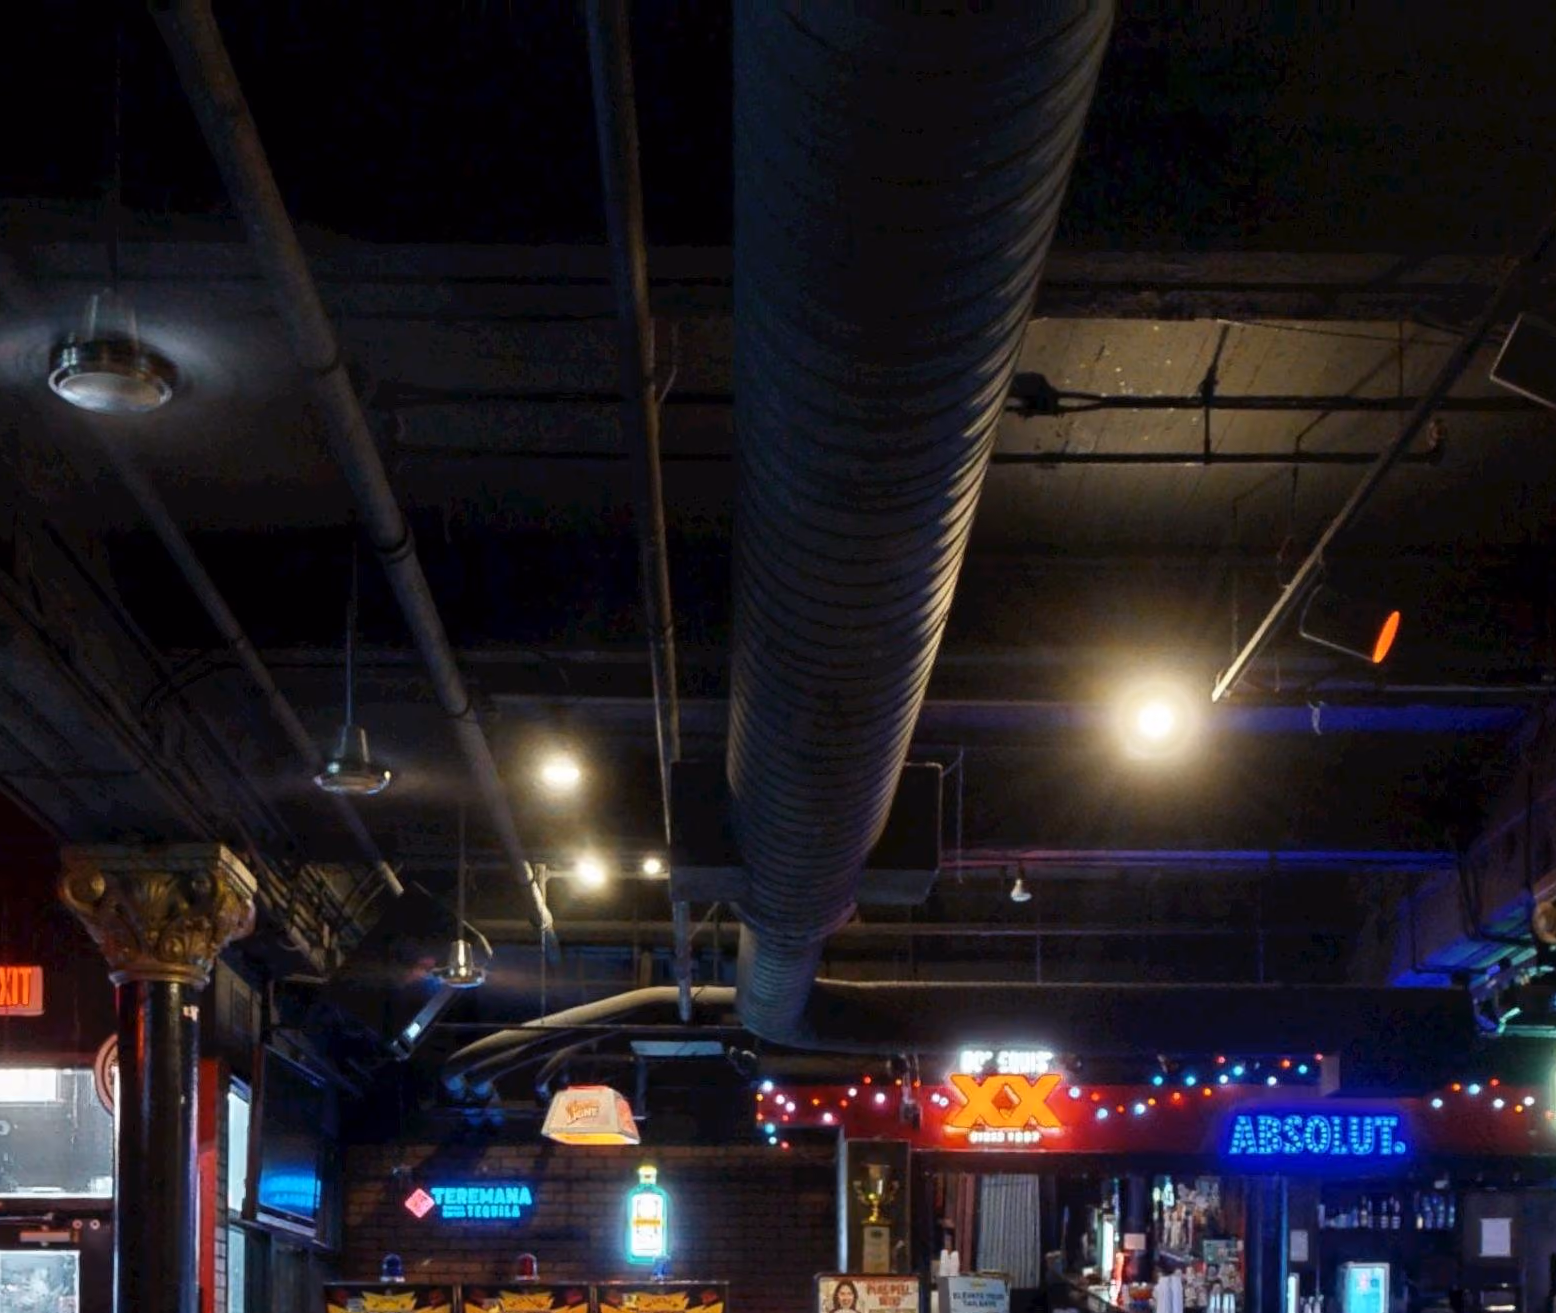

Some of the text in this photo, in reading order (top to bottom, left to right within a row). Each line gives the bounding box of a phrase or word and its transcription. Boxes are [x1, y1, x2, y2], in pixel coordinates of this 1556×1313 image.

[944, 1073, 1063, 1129] XX
[1229, 1115, 1406, 1155] ABSOLUT.
[430, 1186, 533, 1206] TEREMANA
[467, 1205, 521, 1218] TEQUILA
